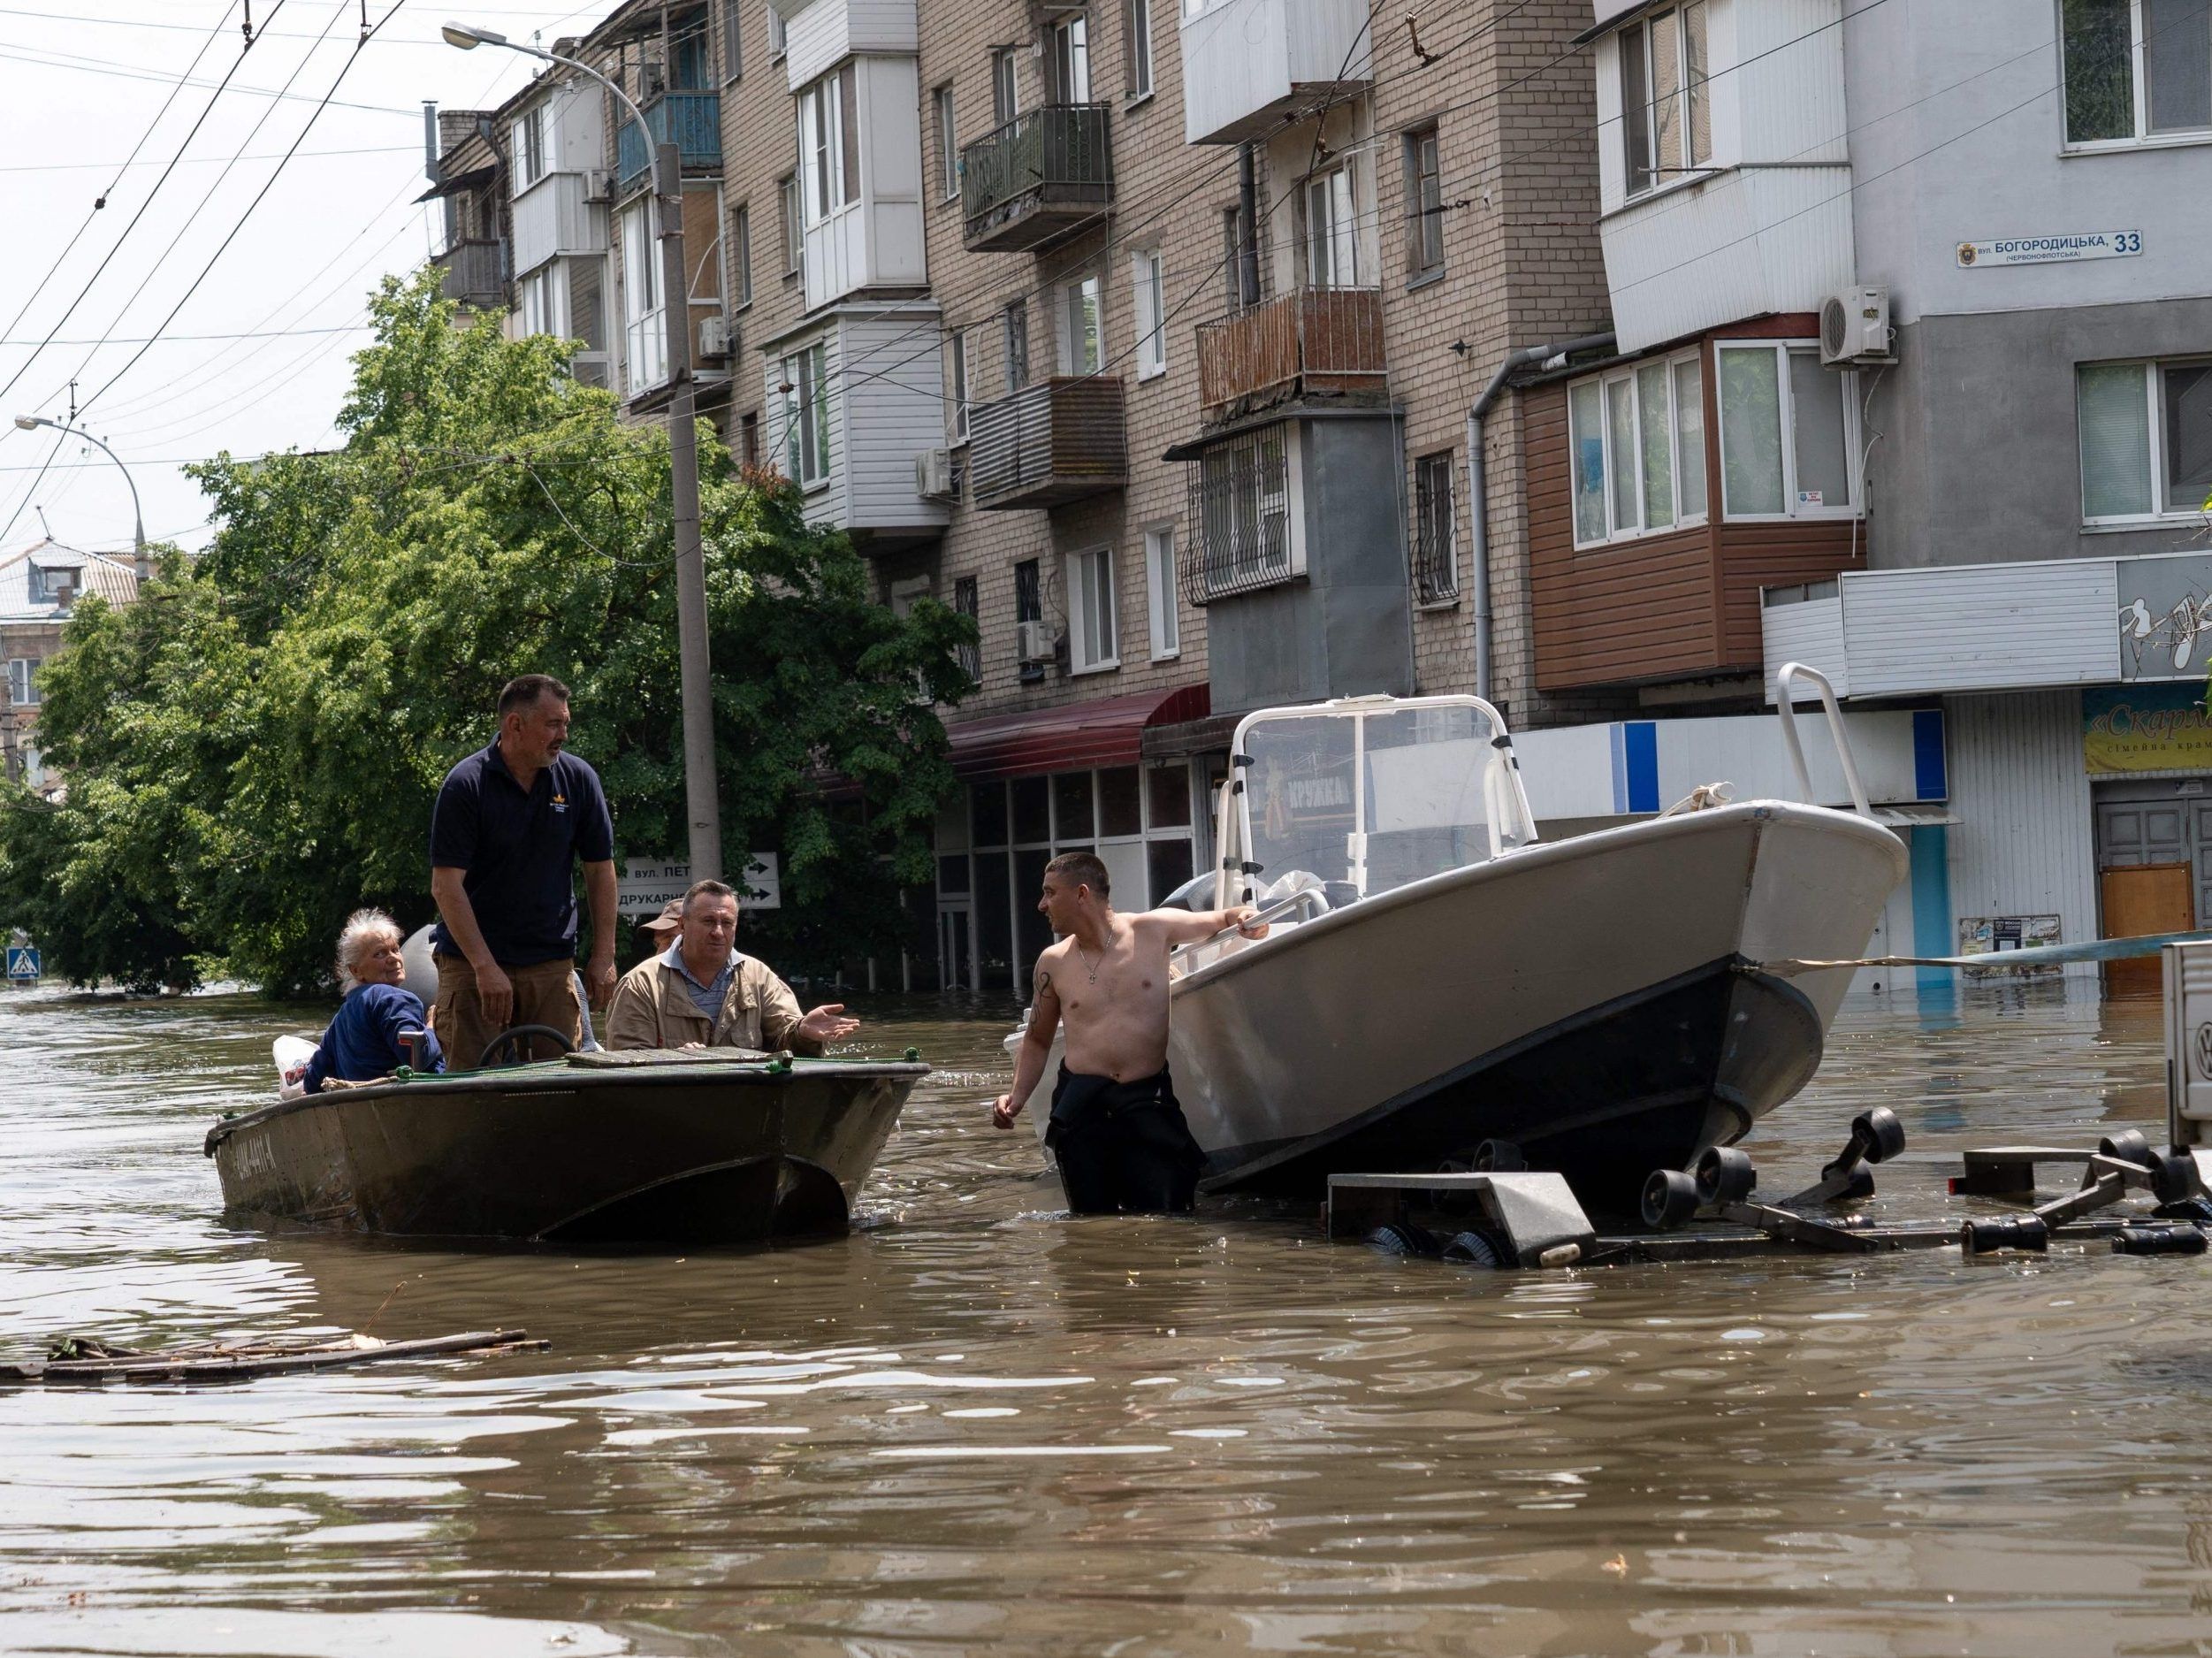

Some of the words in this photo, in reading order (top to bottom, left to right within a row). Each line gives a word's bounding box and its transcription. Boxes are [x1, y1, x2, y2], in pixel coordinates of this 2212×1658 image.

[1995, 235, 2109, 253] БОГОРОДИЦЬКА,
[2115, 233, 2140, 253] 33
[2006, 251, 2081, 262] (ЧЕРВОНОФЛОТСЬКА)
[2107, 744, 2166, 753] сімейна
